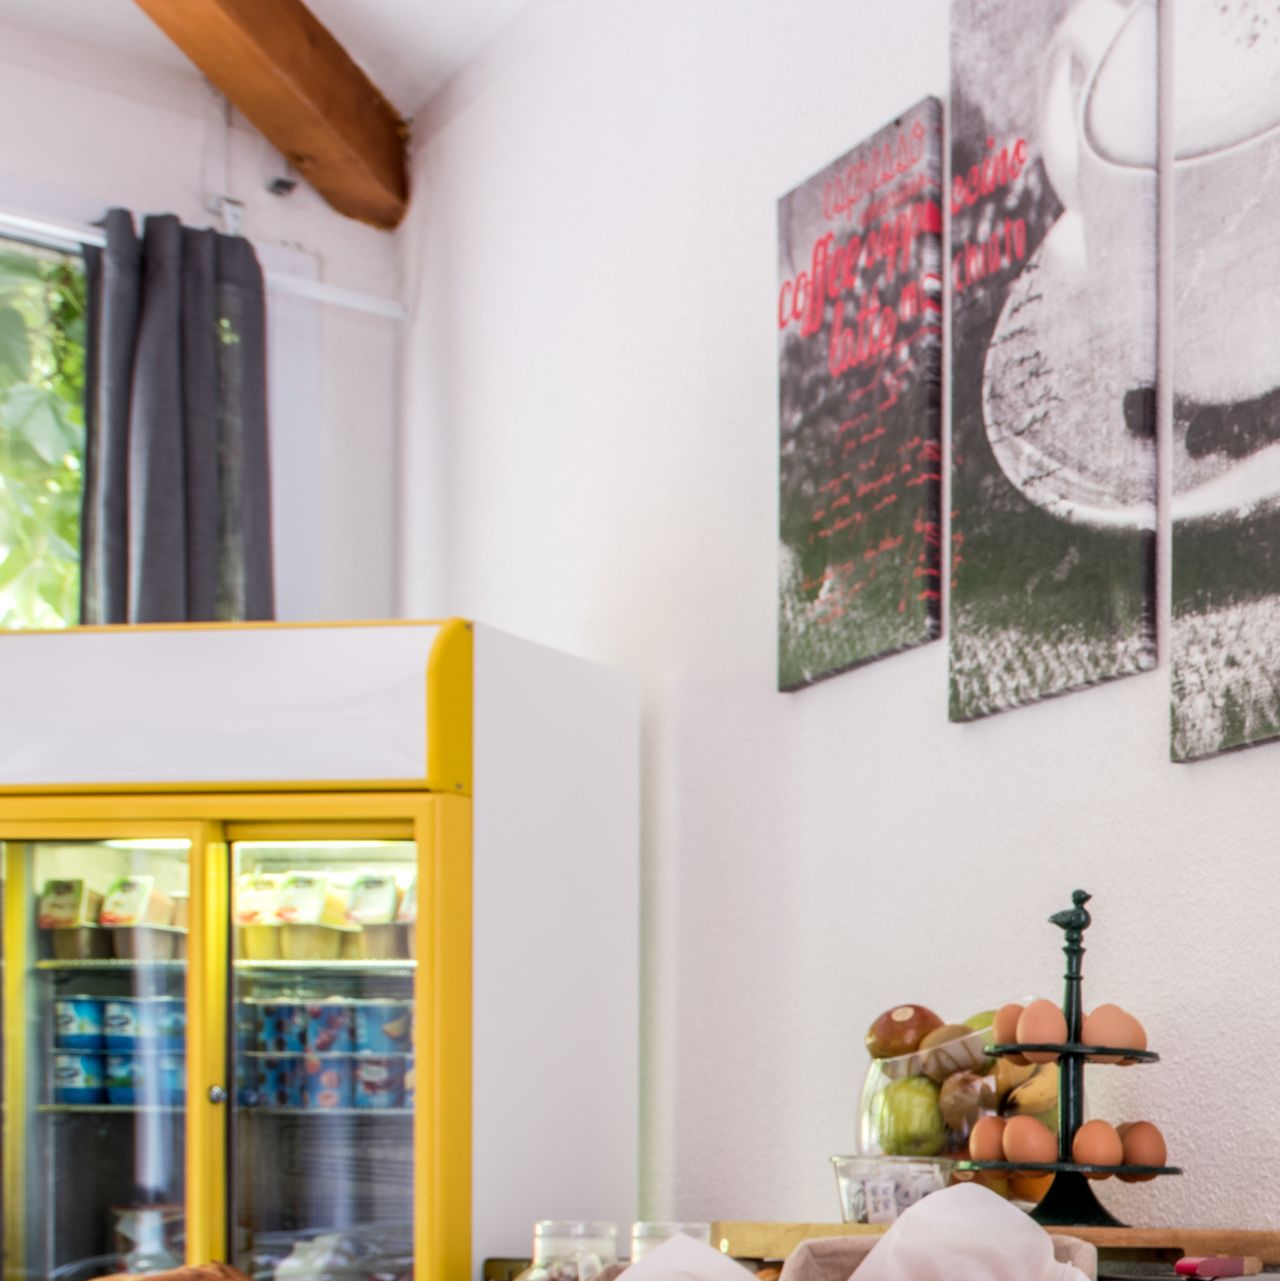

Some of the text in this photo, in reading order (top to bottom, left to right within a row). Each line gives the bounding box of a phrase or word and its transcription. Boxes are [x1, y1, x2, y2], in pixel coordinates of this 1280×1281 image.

[821, 120, 926, 221] espresso
[778, 231, 860, 337] coffee
[827, 291, 897, 378] latte
